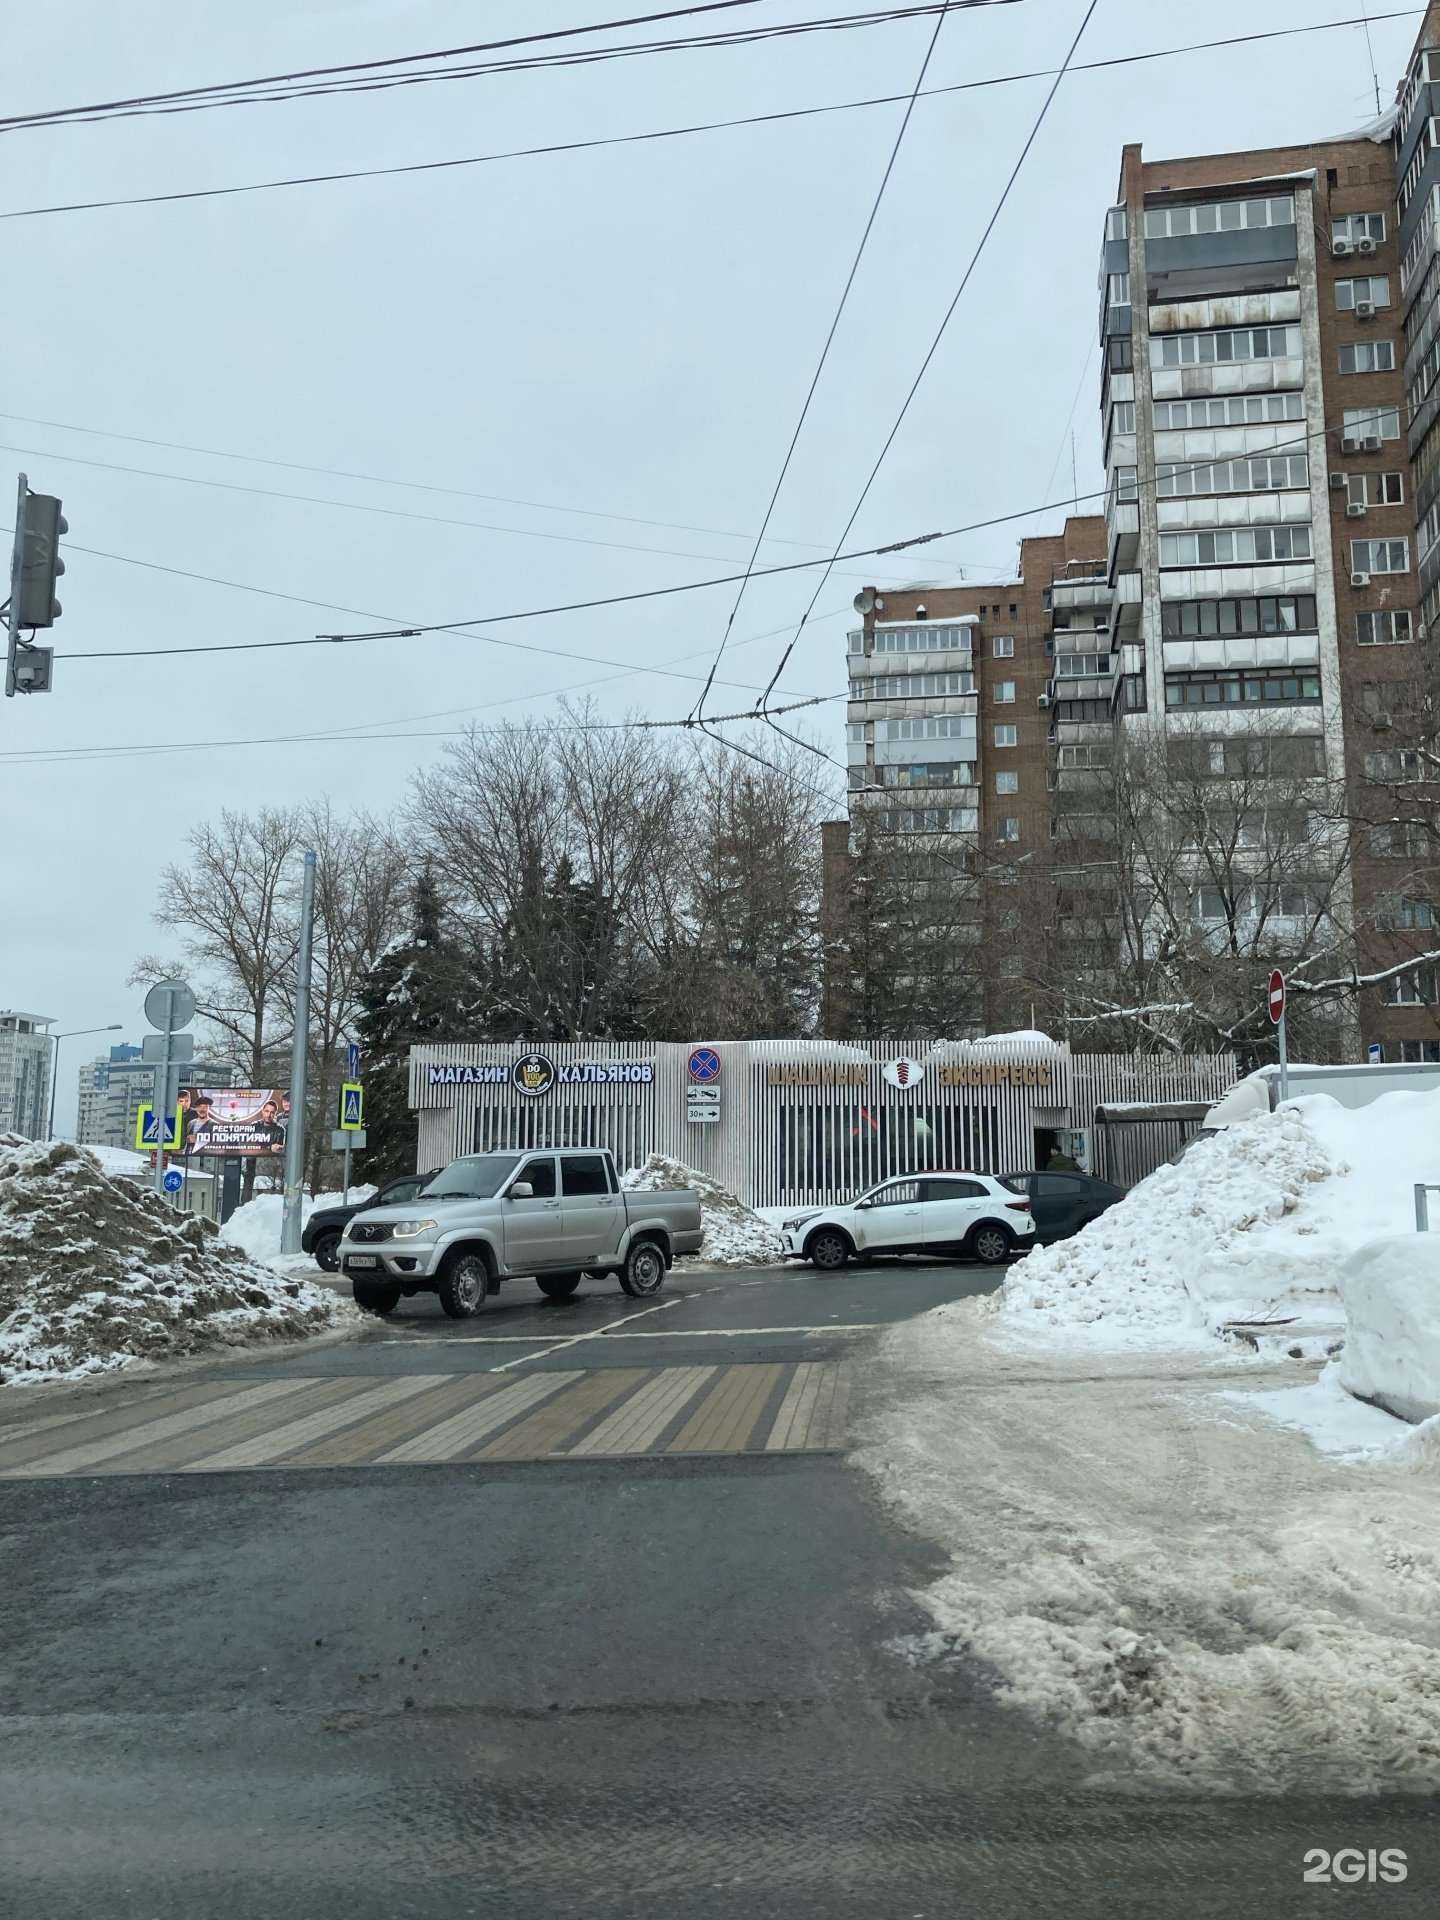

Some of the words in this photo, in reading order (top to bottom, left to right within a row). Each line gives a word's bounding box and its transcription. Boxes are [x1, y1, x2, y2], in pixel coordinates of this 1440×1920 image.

[429, 1066, 509, 1084] МАГАЗИН
[558, 1065, 653, 1084] КАЛЬЯНОВ
[938, 1064, 1052, 1087] ЭКСПРЕСС
[196, 1132, 210, 1142] ПО
[212, 1132, 271, 1143] ПОНЯТИЯМ
